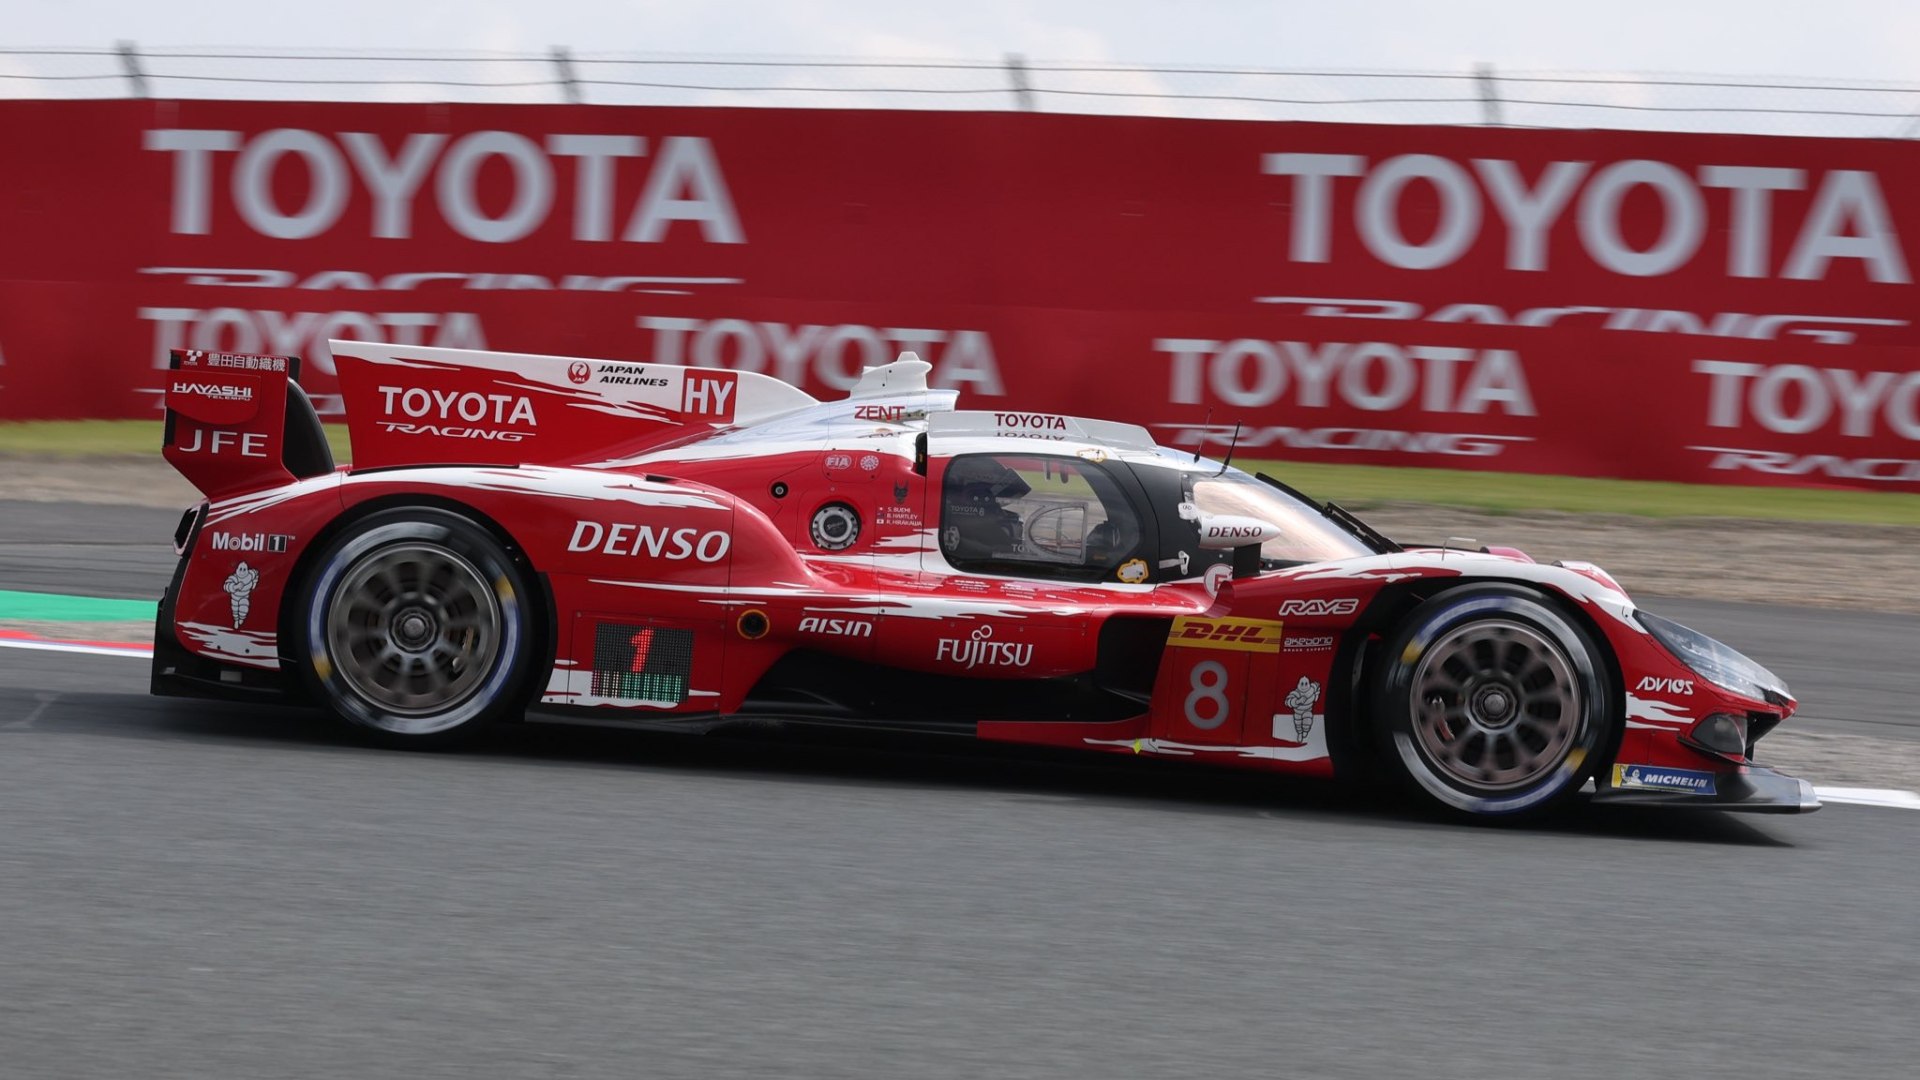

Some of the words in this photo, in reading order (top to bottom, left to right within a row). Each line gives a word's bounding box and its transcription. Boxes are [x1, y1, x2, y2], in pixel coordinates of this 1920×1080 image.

[142, 127, 747, 243] TOYOTA
[1260, 152, 1913, 284] TOYOTA
[207, 353, 285, 371] 豊田自動織機
[598, 365, 645, 375] JAPAN
[600, 376, 669, 387] AIRLINES
[1153, 338, 1539, 416] TOYOTA
[172, 382, 252, 396] HAYASHI
[684, 378, 734, 416] HY
[379, 385, 537, 426] TOYOTA
[854, 405, 905, 421] ZENT
[376, 421, 536, 442] RACING
[994, 413, 1066, 430] TOYOTA
[179, 429, 268, 457] JFE
[1150, 423, 1537, 456] RACING
[827, 457, 849, 467] FIA
[212, 532, 265, 552] Mobil
[567, 520, 731, 563] DENSO
[1208, 527, 1262, 538] DENSO
[1279, 599, 1359, 615] RAYS
[799, 616, 872, 638] AISIN
[1180, 622, 1268, 644] DHL
[630, 626, 655, 673] 1
[936, 638, 1034, 669] FUJITSU
[1184, 660, 1230, 730] 8
[1644, 773, 1707, 788] MICHELIN
